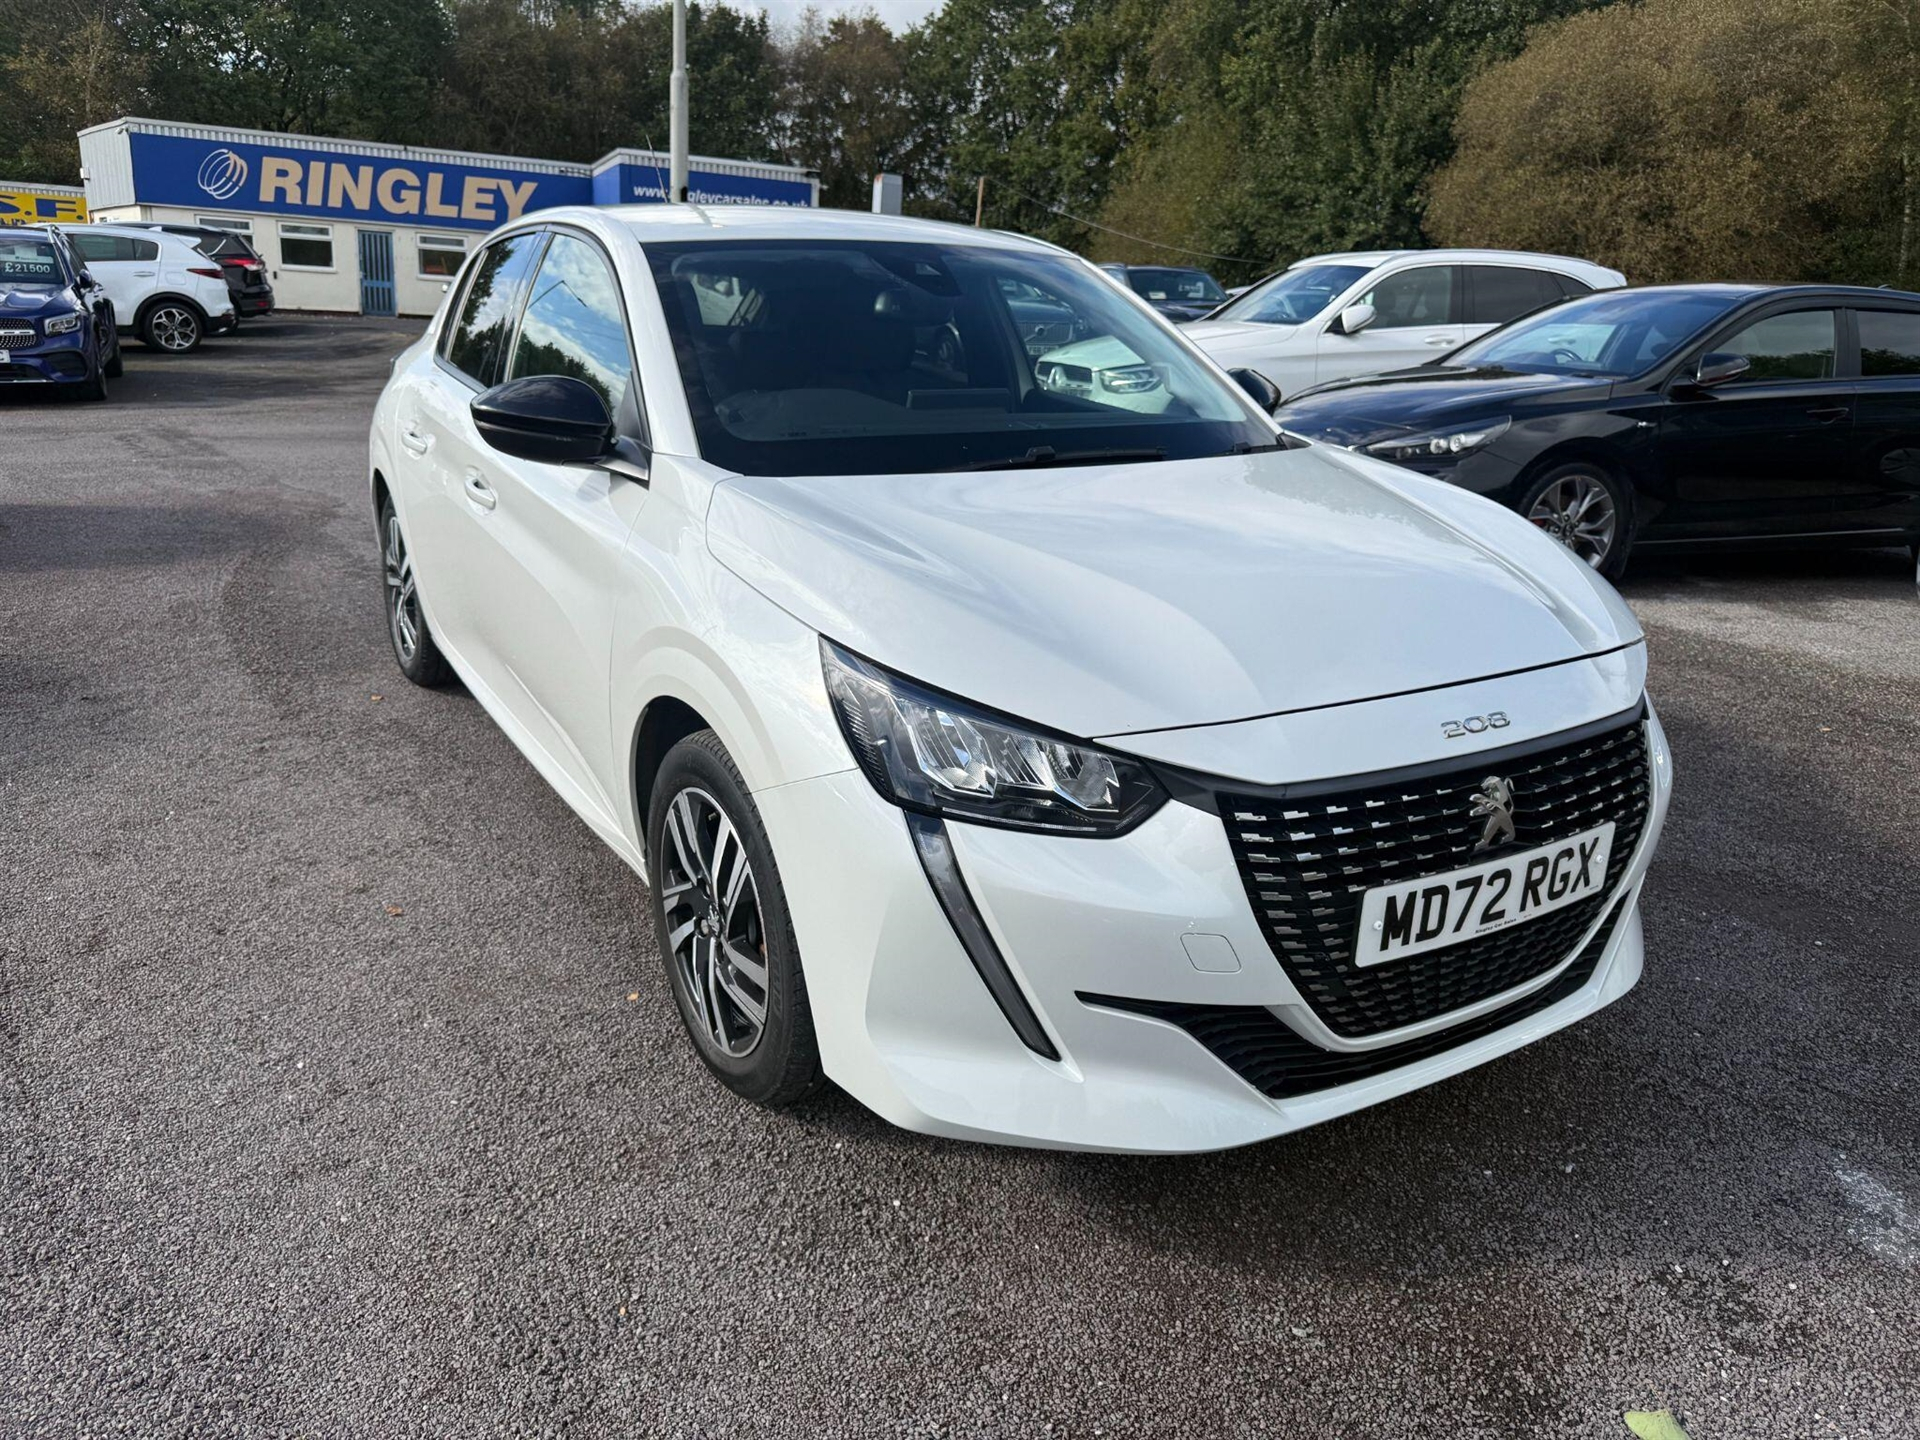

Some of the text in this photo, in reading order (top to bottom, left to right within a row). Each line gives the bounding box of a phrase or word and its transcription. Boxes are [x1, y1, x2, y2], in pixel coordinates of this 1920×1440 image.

[259, 156, 538, 222] RINGLEY
[5, 262, 51, 273] £21500
[1441, 711, 1511, 739] 208
[1379, 836, 1600, 952] MD72 RGX
